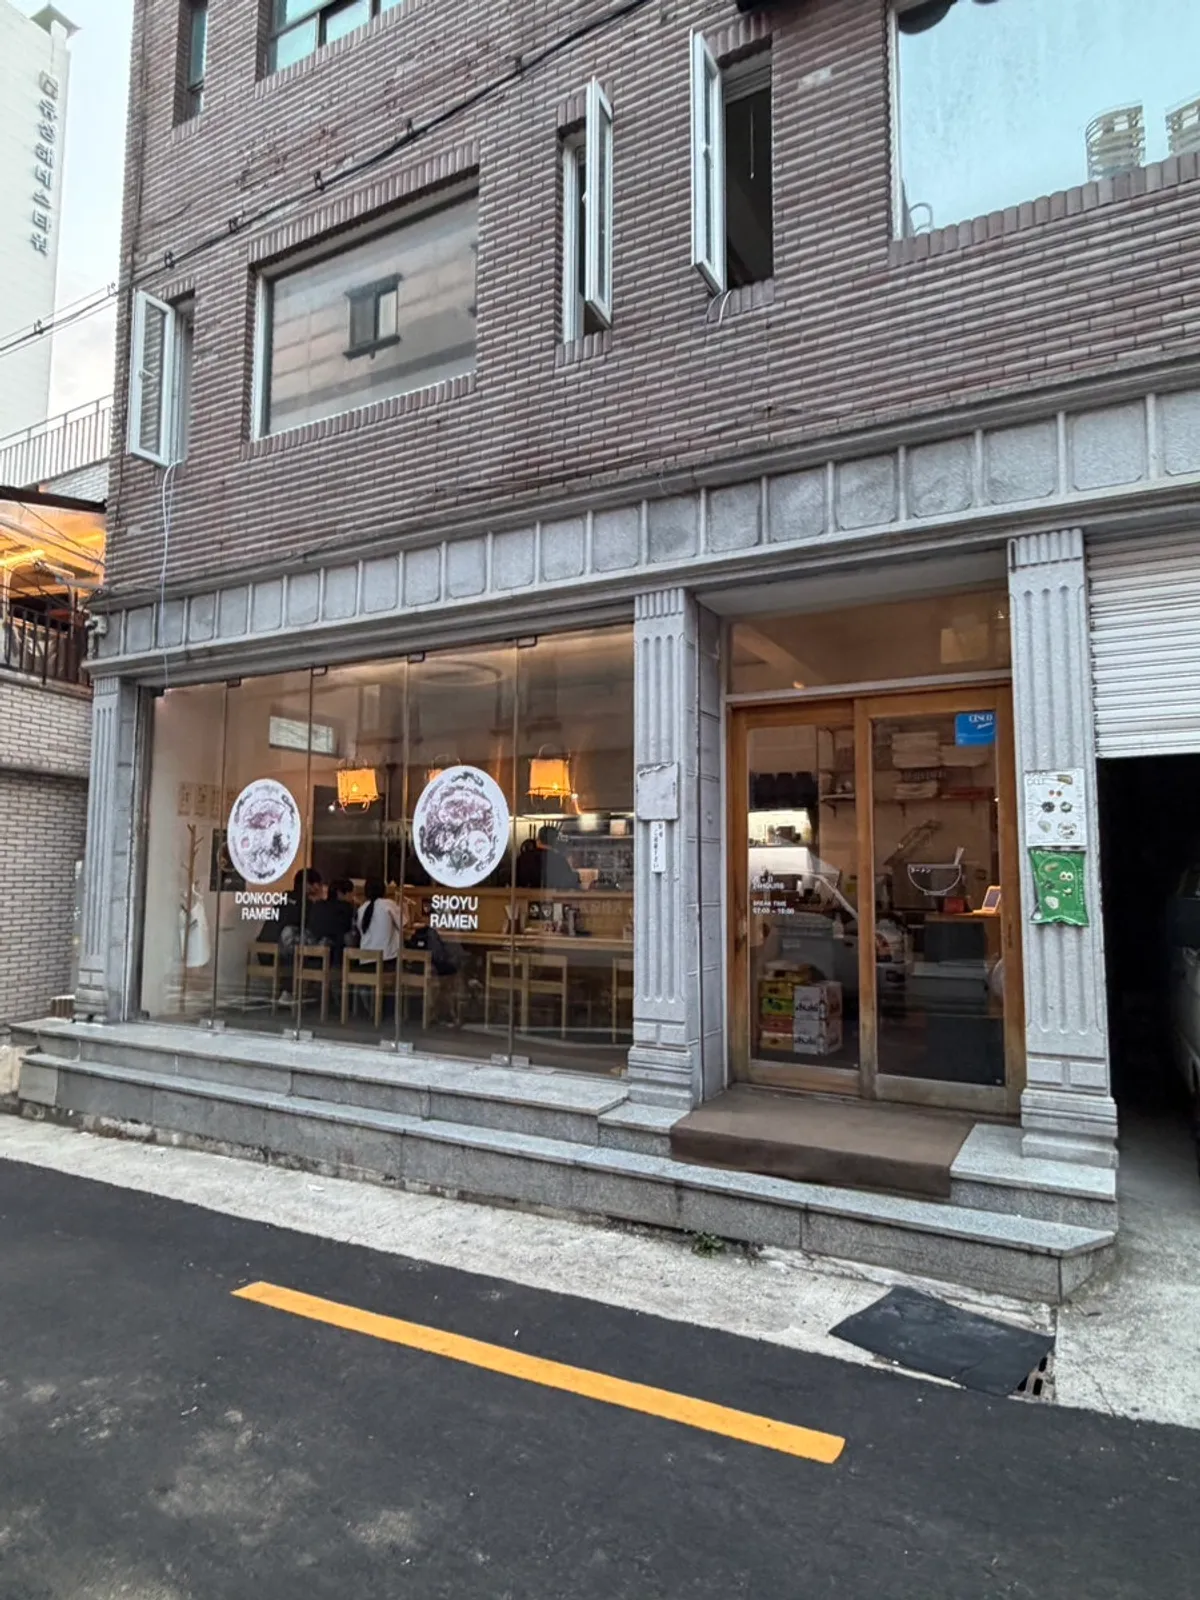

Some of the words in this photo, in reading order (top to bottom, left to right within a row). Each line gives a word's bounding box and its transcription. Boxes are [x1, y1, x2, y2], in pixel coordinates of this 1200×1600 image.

[235, 892, 288, 906] DONKOCH
[431, 895, 479, 911] SHOYU
[241, 907, 280, 921] RAMEN
[430, 913, 479, 929] RAMEN
